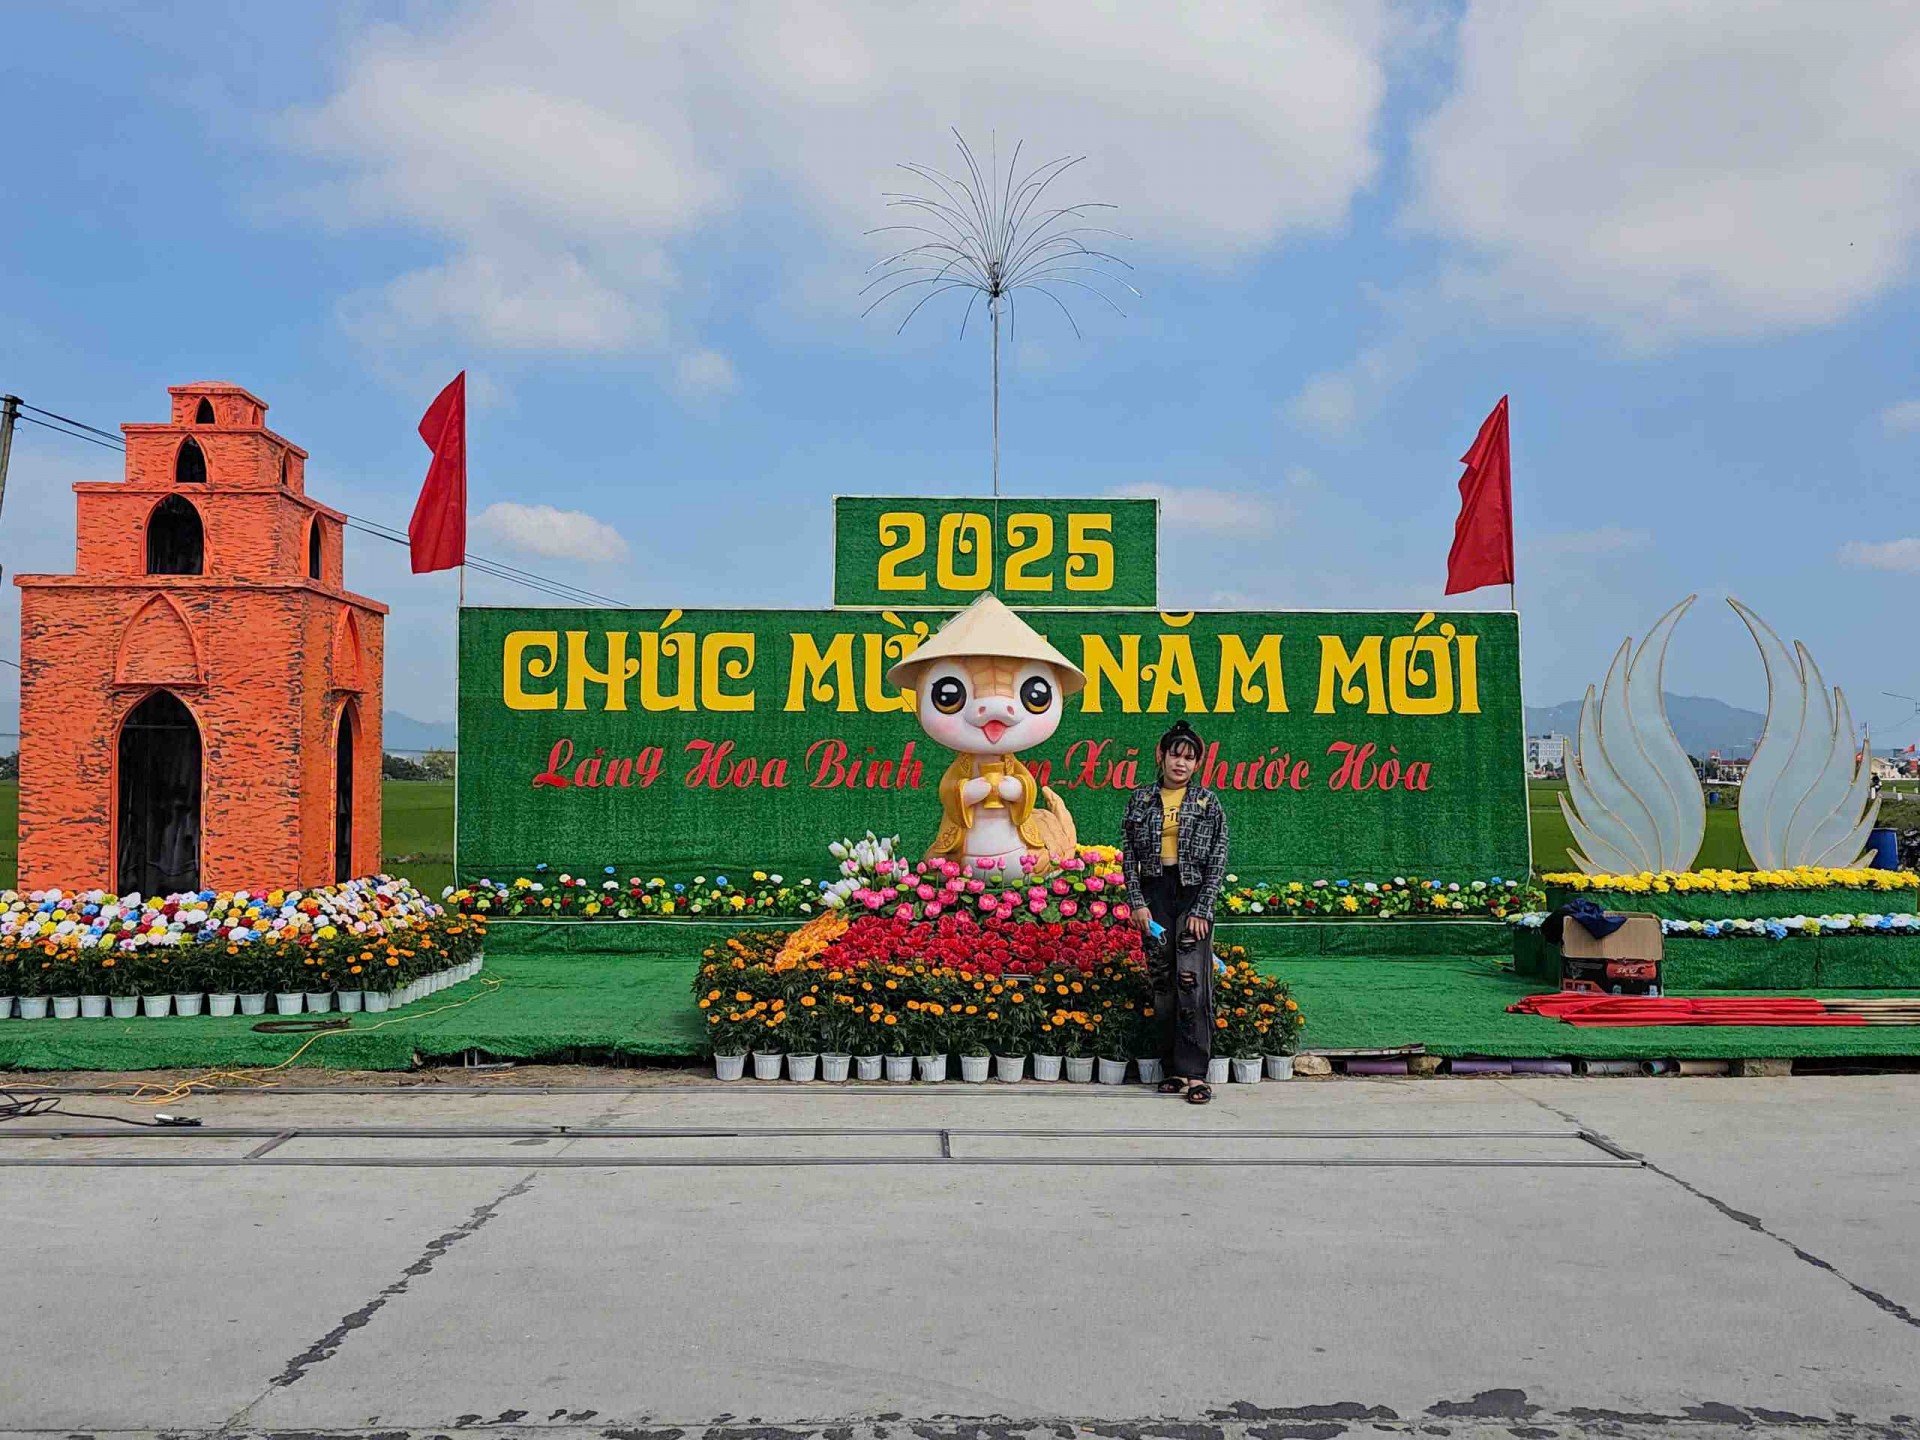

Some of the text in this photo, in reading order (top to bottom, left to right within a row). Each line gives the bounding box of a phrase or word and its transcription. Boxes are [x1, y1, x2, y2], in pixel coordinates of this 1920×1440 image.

[877, 511, 1115, 592] 2025
[502, 609, 1482, 715] CHÚC MỪ NĂM MỚI
[684, 738, 791, 789] Hoa
[1326, 740, 1435, 791] Hòa
